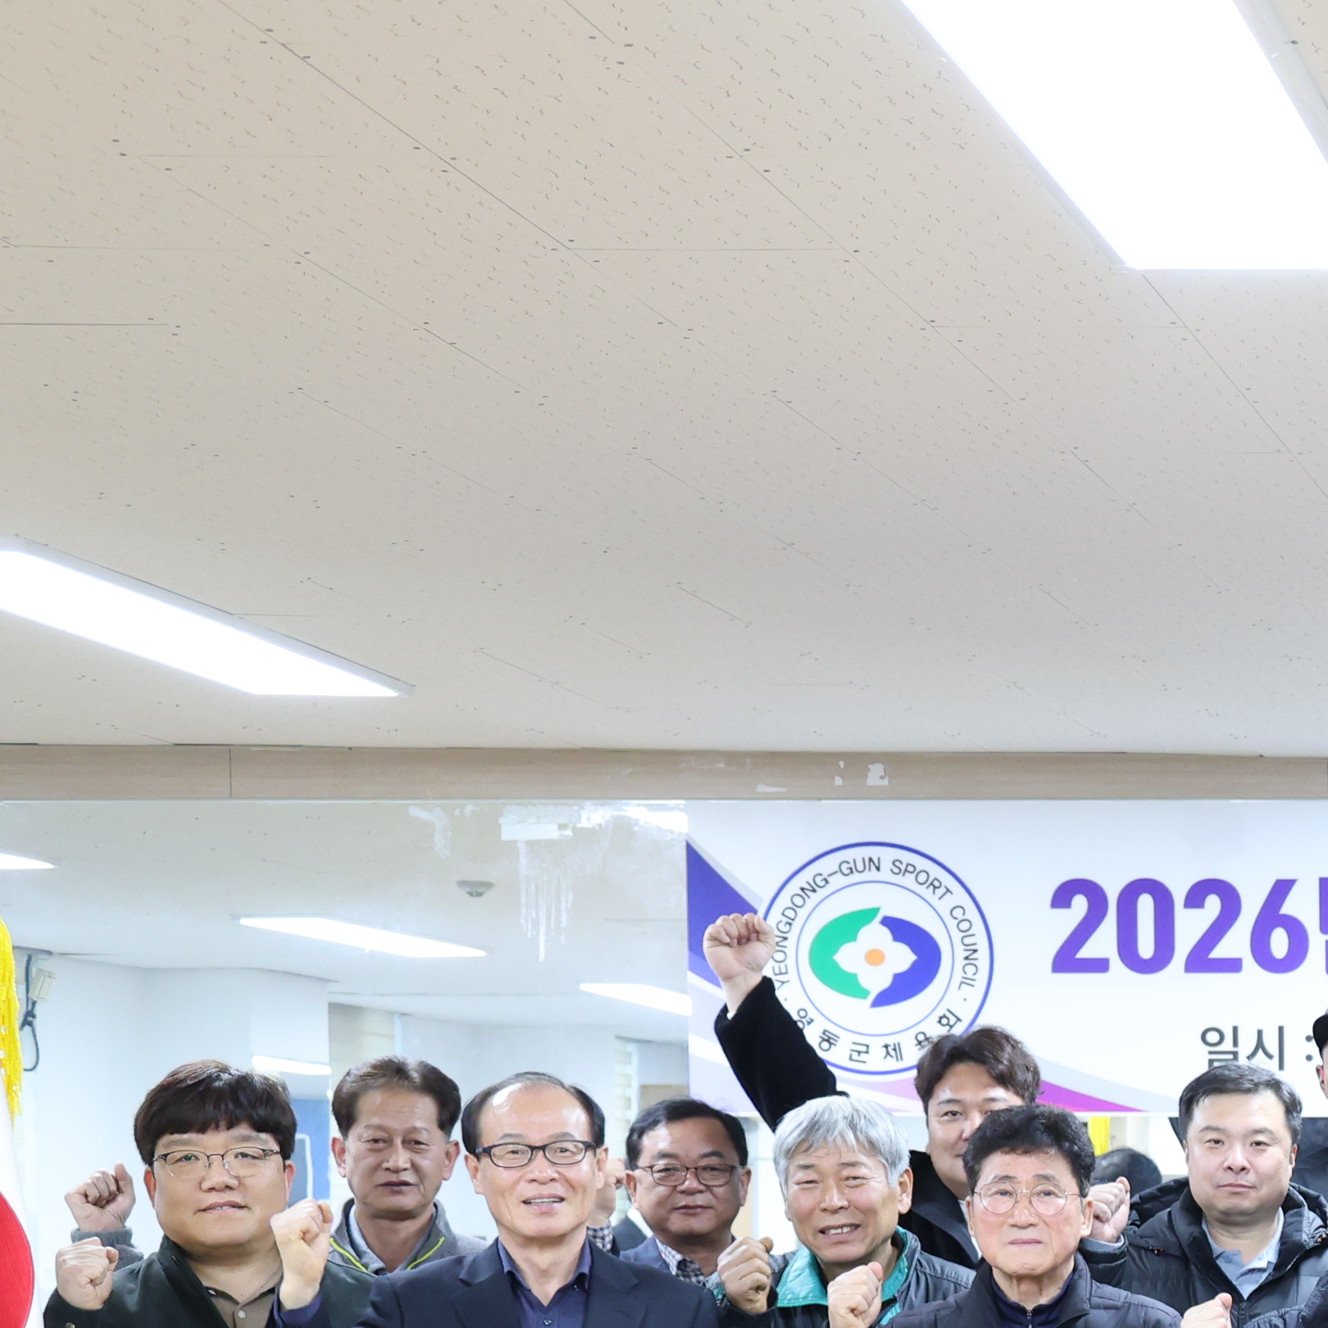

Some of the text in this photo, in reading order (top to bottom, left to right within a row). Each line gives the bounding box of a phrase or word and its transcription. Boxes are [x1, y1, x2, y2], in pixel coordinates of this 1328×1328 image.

[771, 856, 979, 991] YEONGDONG-GUN SPORT COUNCIL
[1199, 1025, 1286, 1072] 일시
